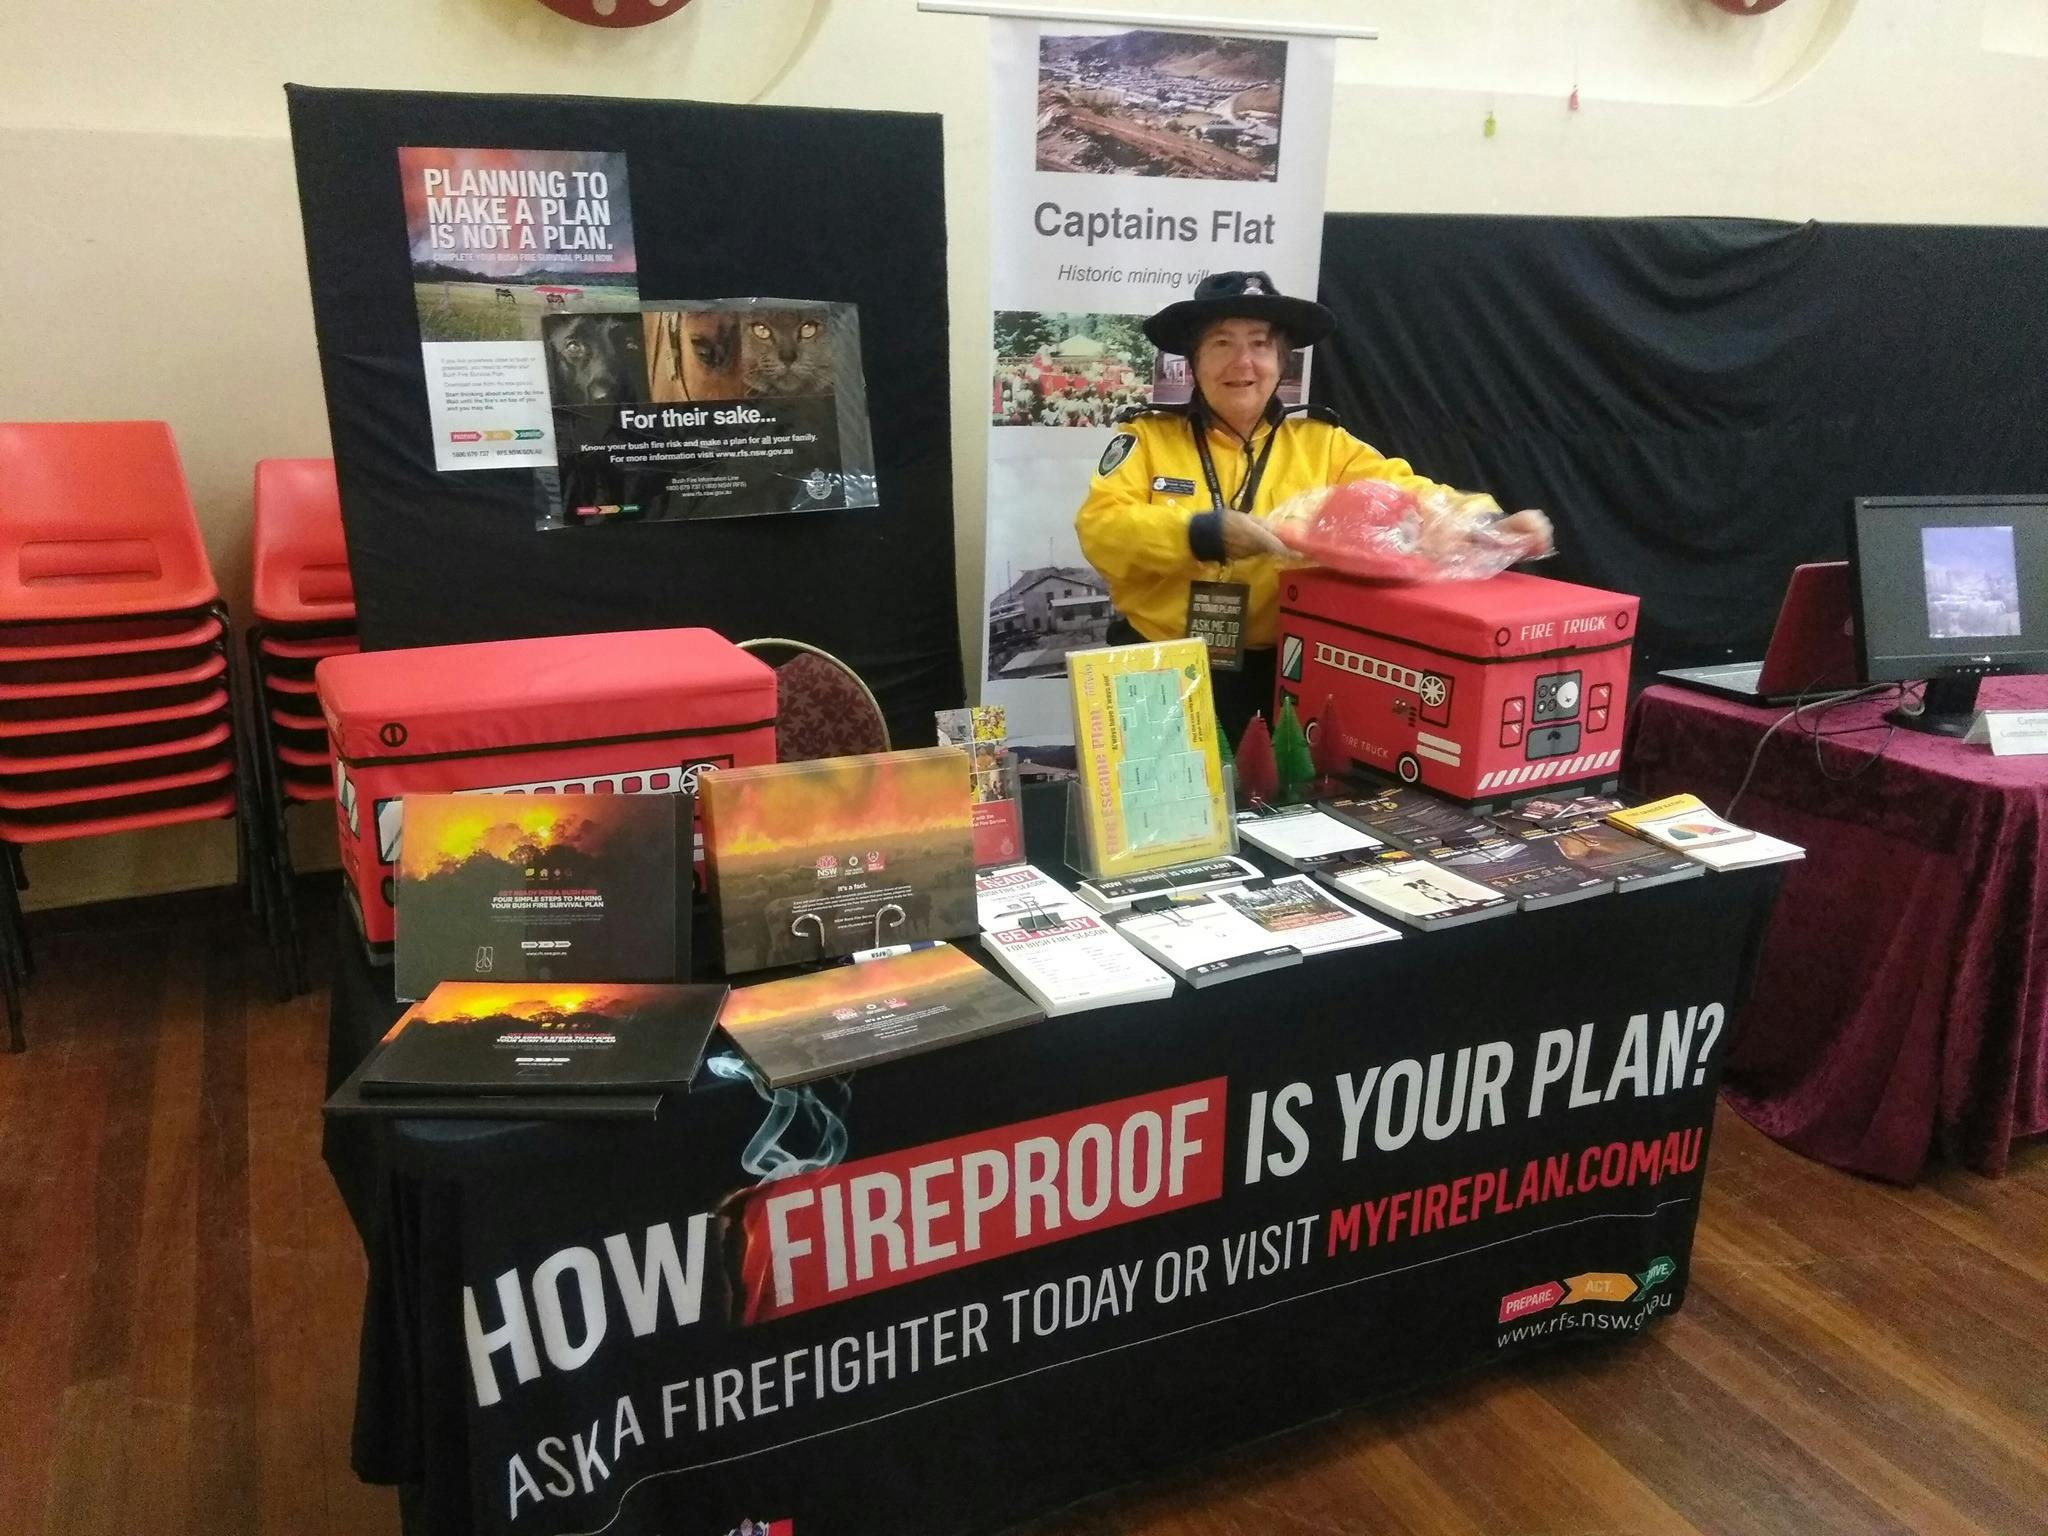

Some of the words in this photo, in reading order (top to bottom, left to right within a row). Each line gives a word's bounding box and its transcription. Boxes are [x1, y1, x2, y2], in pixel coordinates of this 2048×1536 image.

[424, 168, 567, 198] PLANNING
[572, 171, 608, 199] TO
[427, 198, 508, 224] MAKE
[515, 199, 535, 225] A
[541, 199, 612, 226] PLAN
[1034, 202, 1197, 247] Captains
[1212, 210, 1276, 245] Flat
[430, 225, 456, 250] IS
[462, 225, 511, 249] NOT
[519, 226, 537, 250] A
[543, 225, 614, 250] PLAN.
[1058, 264, 1123, 283] Historic
[1128, 268, 1182, 288] mining
[620, 410, 657, 430] For
[662, 407, 709, 428] their
[713, 405, 776, 426] sake...
[581, 444, 606, 452] Know
[608, 443, 626, 452] your
[628, 441, 649, 450] bush
[651, 440, 664, 450] fire
[666, 440, 682, 448] risk
[684, 439, 699, 448] and
[700, 438, 722, 446] make
[730, 438, 747, 446] plan
[748, 436, 760, 444] for
[762, 436, 772, 445] all
[773, 436, 790, 444] your
[792, 434, 818, 444] family.
[610, 455, 625, 463] For
[650, 452, 696, 462] information
[698, 451, 714, 460] visit
[716, 448, 794, 458] www.rfs.nsw.gov.au
[1192, 620, 1210, 632] ASK
[1210, 620, 1225, 633] ME
[1226, 622, 1240, 634] TO
[1521, 622, 1555, 640] FIRE
[1563, 616, 1606, 635] TRUCK
[1214, 634, 1238, 648] OUT
[1362, 741, 1389, 758] TRUCK
[817, 868, 837, 877] NSW
[982, 872, 1032, 889] READY
[1100, 880, 1122, 890] HOW
[1181, 866, 1203, 876] YOUR
[1202, 862, 1232, 872] PLAN?
[854, 882, 868, 890] fact.
[1007, 944, 1024, 952] FOR
[1073, 928, 1108, 940] SEASON
[463, 1212, 714, 1407] HOW
[765, 1096, 1210, 1308] FIREPROOF
[1245, 1081, 1313, 1185] IS
[1335, 1040, 1514, 1162] YOUR
[1528, 1002, 1726, 1118] PLAN?
[1506, 1289, 1554, 1314] PREPARE.
[509, 1419, 610, 1521] ASK
[614, 1395, 645, 1462] A
[662, 1302, 991, 1440] FIREFIGHTER
[1002, 1258, 1143, 1344] TODAY
[1154, 1243, 1208, 1304] OR
[1222, 1214, 1319, 1286] VISIT
